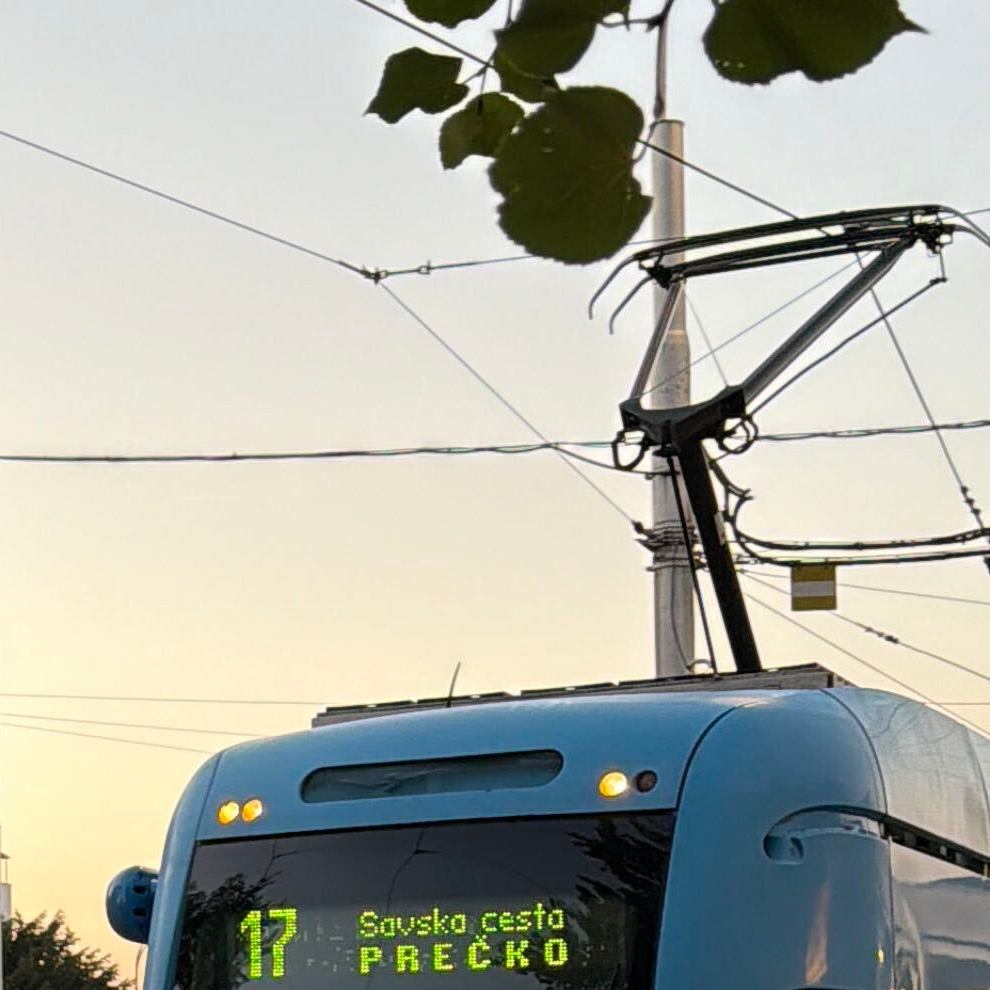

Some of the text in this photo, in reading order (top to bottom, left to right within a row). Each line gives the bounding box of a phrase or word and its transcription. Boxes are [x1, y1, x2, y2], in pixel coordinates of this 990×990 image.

[358, 902, 565, 937] Savska cesta
[240, 907, 298, 978] 17
[359, 934, 569, 975] PREČKO
